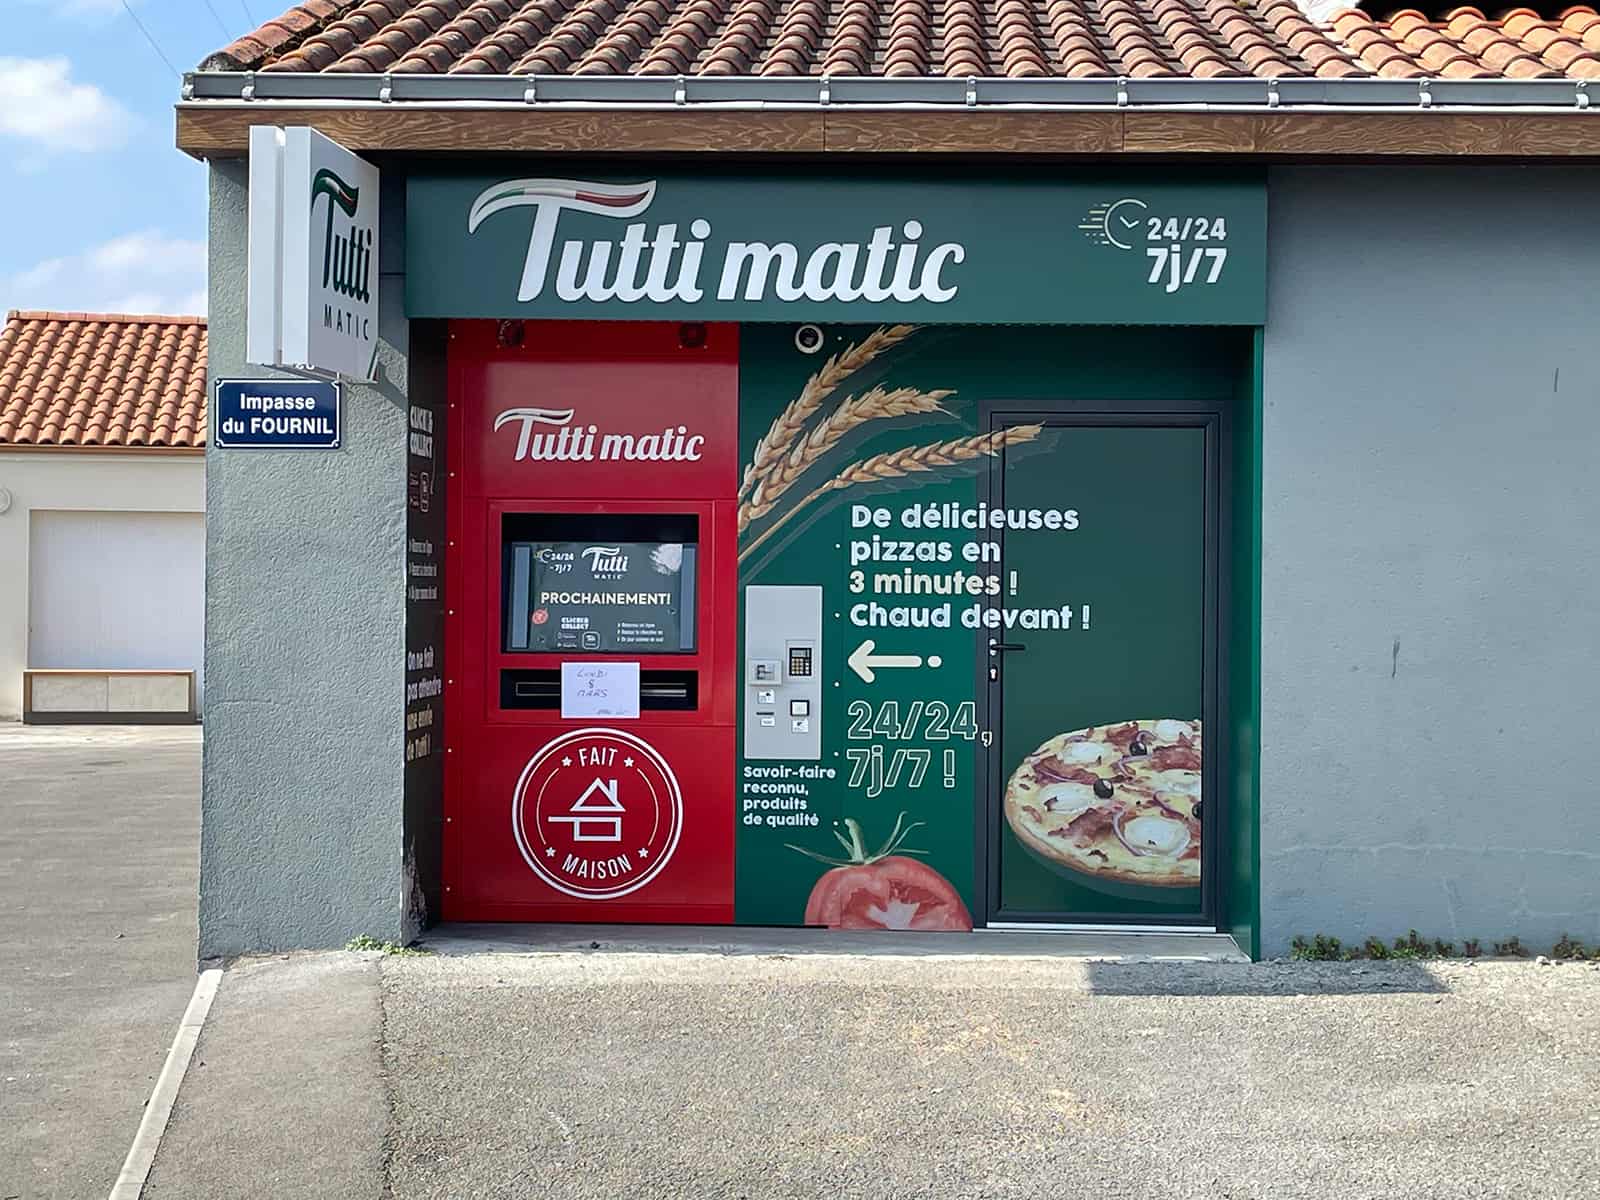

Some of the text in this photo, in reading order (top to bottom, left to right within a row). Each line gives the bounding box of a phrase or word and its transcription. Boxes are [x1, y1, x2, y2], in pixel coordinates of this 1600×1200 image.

[310, 167, 372, 305] Tutti
[468, 178, 966, 303] Tutti matic
[1147, 216, 1227, 241] 24/24
[1146, 243, 1228, 293] 7j/7
[323, 305, 370, 342] MATIC
[239, 393, 316, 413] Impasse
[221, 416, 334, 435] du FOURNIL
[493, 408, 705, 462] Tutti matic
[850, 502, 1080, 530] De délicieuses
[581, 546, 629, 573] Tutti
[850, 534, 1002, 566] pizzas en
[849, 568, 1018, 596] 3 minutes !
[540, 591, 671, 605] PROCHAINEMENT!
[849, 602, 1090, 630] Chaud devant !
[578, 746, 619, 767] FAIT
[743, 764, 837, 779] Savoir-faire
[846, 745, 956, 798] 7j/7 !
[743, 783, 809, 796] reconnu,
[743, 797, 808, 812] produits
[743, 812, 820, 829] de qualité
[561, 853, 633, 880] MAISON
